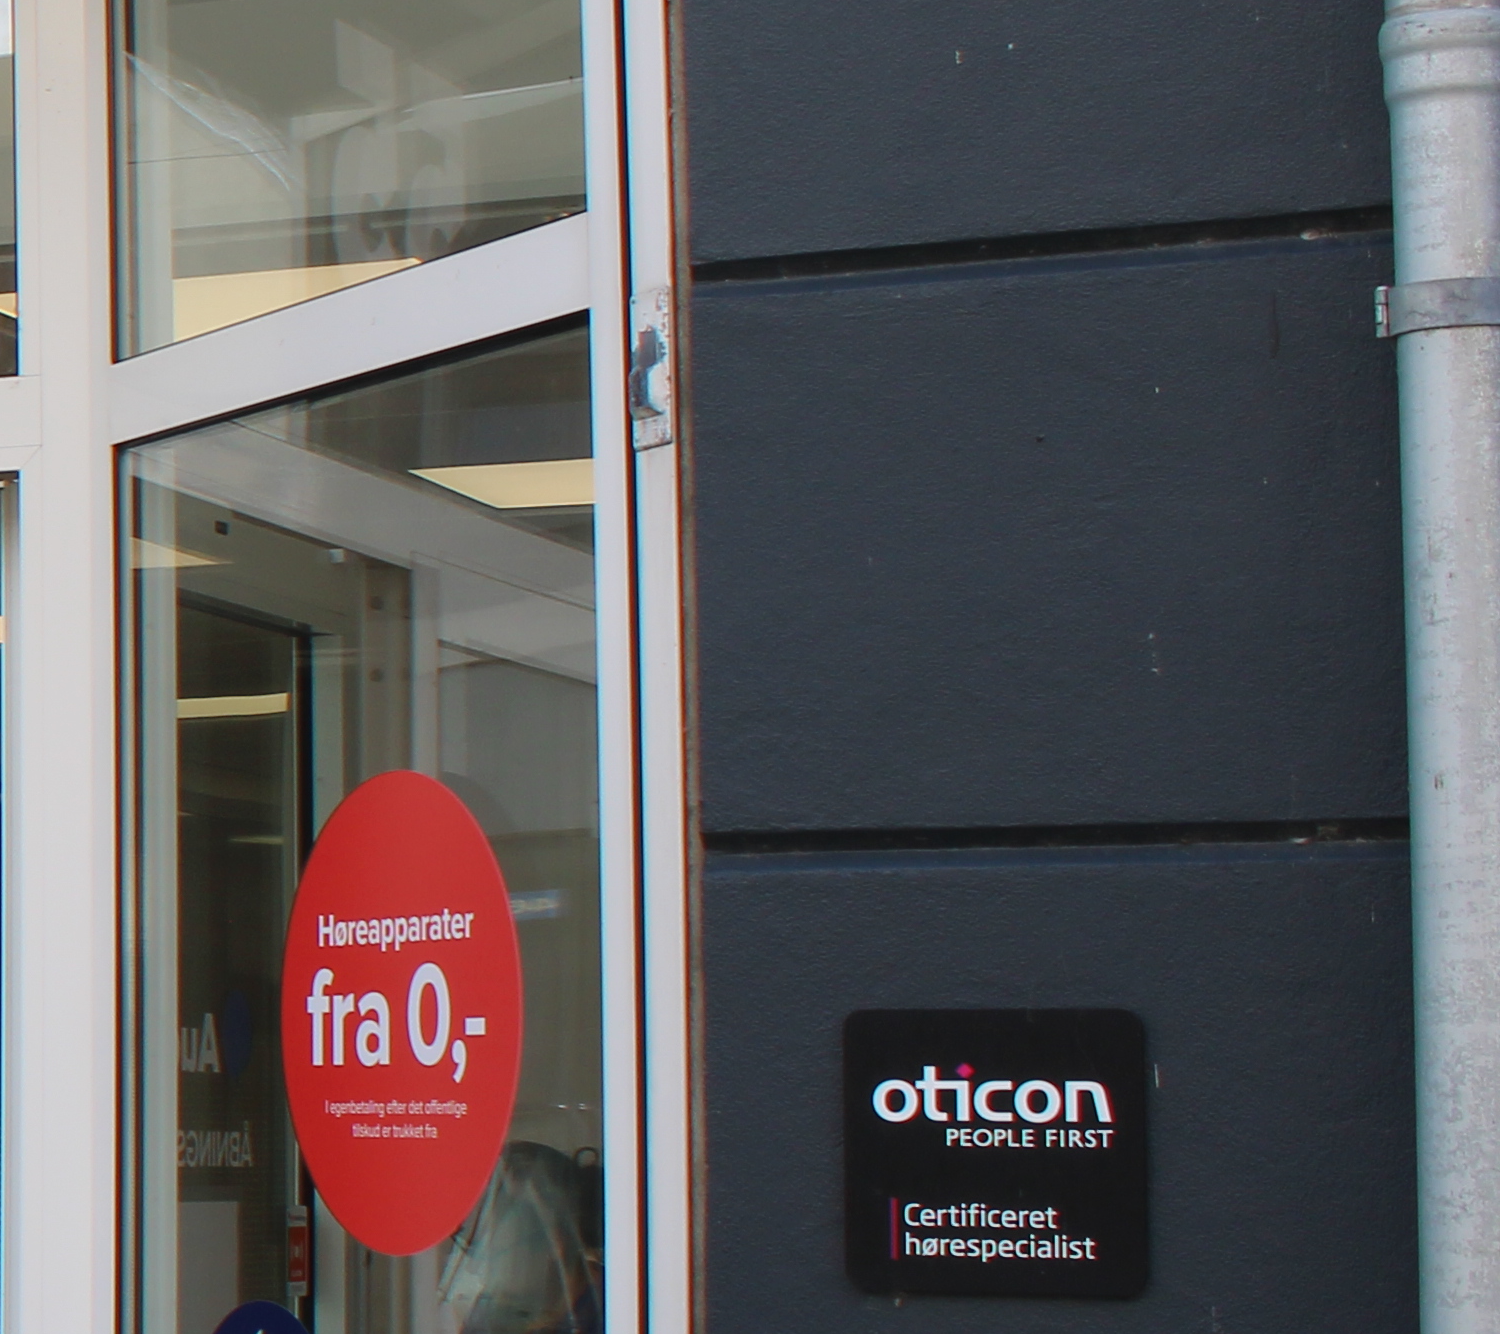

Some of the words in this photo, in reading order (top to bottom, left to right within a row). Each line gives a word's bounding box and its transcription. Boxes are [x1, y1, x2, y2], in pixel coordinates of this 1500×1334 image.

[318, 908, 474, 951] Høreapparater
[307, 968, 391, 1067] fra
[407, 962, 486, 1084] 0,-
[872, 1063, 1114, 1123] oticon
[330, 1100, 385, 1118] egenbetaling
[386, 1100, 406, 1115] efter
[408, 1100, 423, 1115] det
[425, 1100, 468, 1118] offentlige
[352, 1123, 380, 1138] tilskud
[382, 1126, 392, 1138] er
[393, 1123, 424, 1138] trukket
[425, 1124, 438, 1138] fra
[946, 1128, 1036, 1147] PEOPLE
[1045, 1129, 1114, 1148] FIRST
[904, 1203, 1058, 1229] Certificeret
[904, 1231, 1096, 1262] hørespecialist
